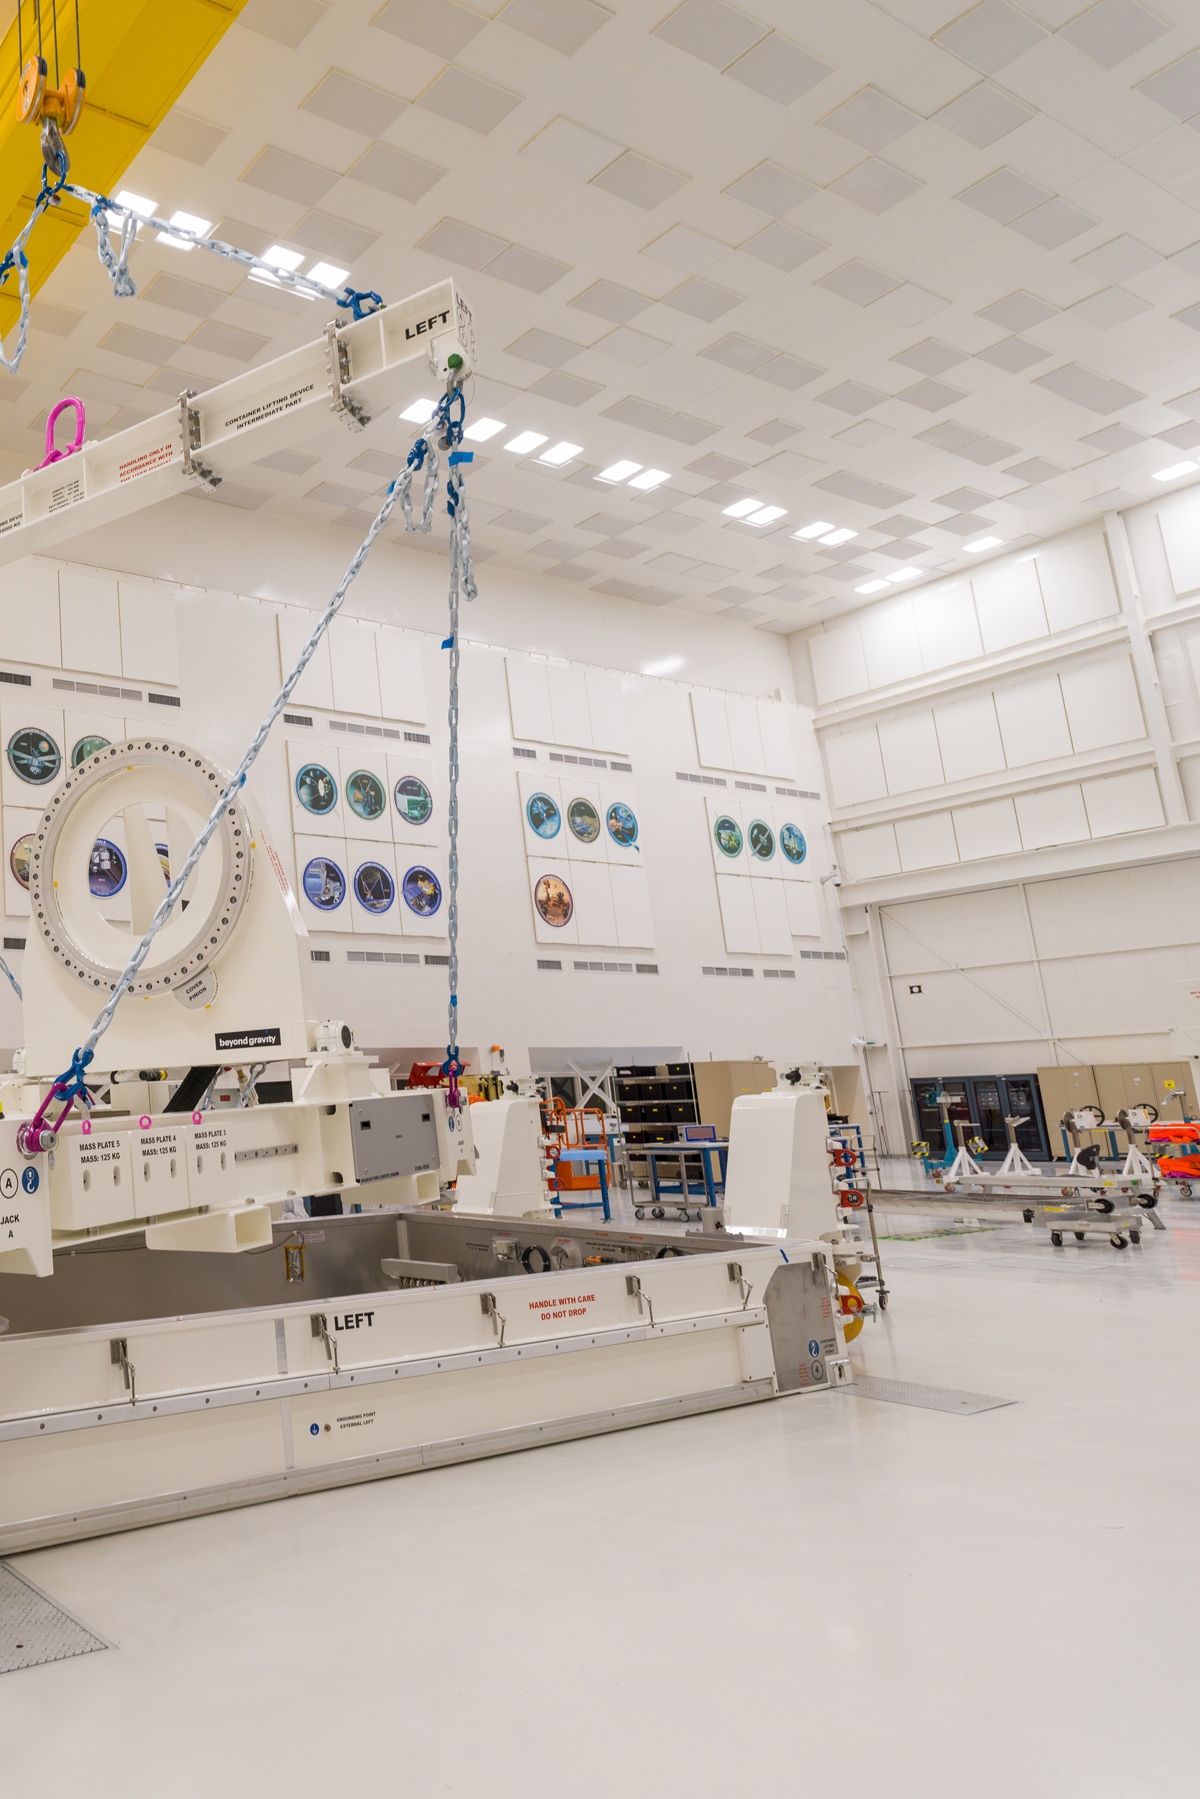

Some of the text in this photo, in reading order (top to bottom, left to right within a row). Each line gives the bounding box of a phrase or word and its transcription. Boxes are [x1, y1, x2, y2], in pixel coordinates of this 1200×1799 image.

[456, 291, 472, 322] LEFT
[405, 310, 450, 340] LEFT
[225, 384, 314, 427] CONTAINER LIFTING DEVICE
[236, 397, 302, 430] INTERMEDIATE PART
[119, 443, 172, 470] HANDLING ONLY IN
[119, 450, 173, 478] ACCORDANCE WITH
[9, 513, 23, 523] DEVIC
[13, 522, 21, 530] KG
[185, 980, 203, 994] COVER
[189, 986, 207, 1001] PINION
[219, 1034, 276, 1047] beyond gravity
[208, 1130, 223, 1138] PLATE
[79, 1142, 96, 1151] MASS
[98, 1141, 115, 1149] PLATE
[140, 1137, 156, 1145] MASS
[156, 1136, 172, 1144] PLATE
[80, 1152, 120, 1164] MASS: 125 KG
[142, 1148, 159, 1156] MASS:
[5, 1178, 13, 1189] A
[0, 1214, 20, 1225] JACK
[8, 1230, 14, 1238] A
[529, 1294, 596, 1310] HANDLE WITH CARE
[541, 1308, 587, 1321] DO NOT DROP
[334, 1311, 375, 1331] LEFT
[336, 1411, 376, 1423] GROUNDING POINT
[340, 1421, 362, 1429] EXTERNAL
